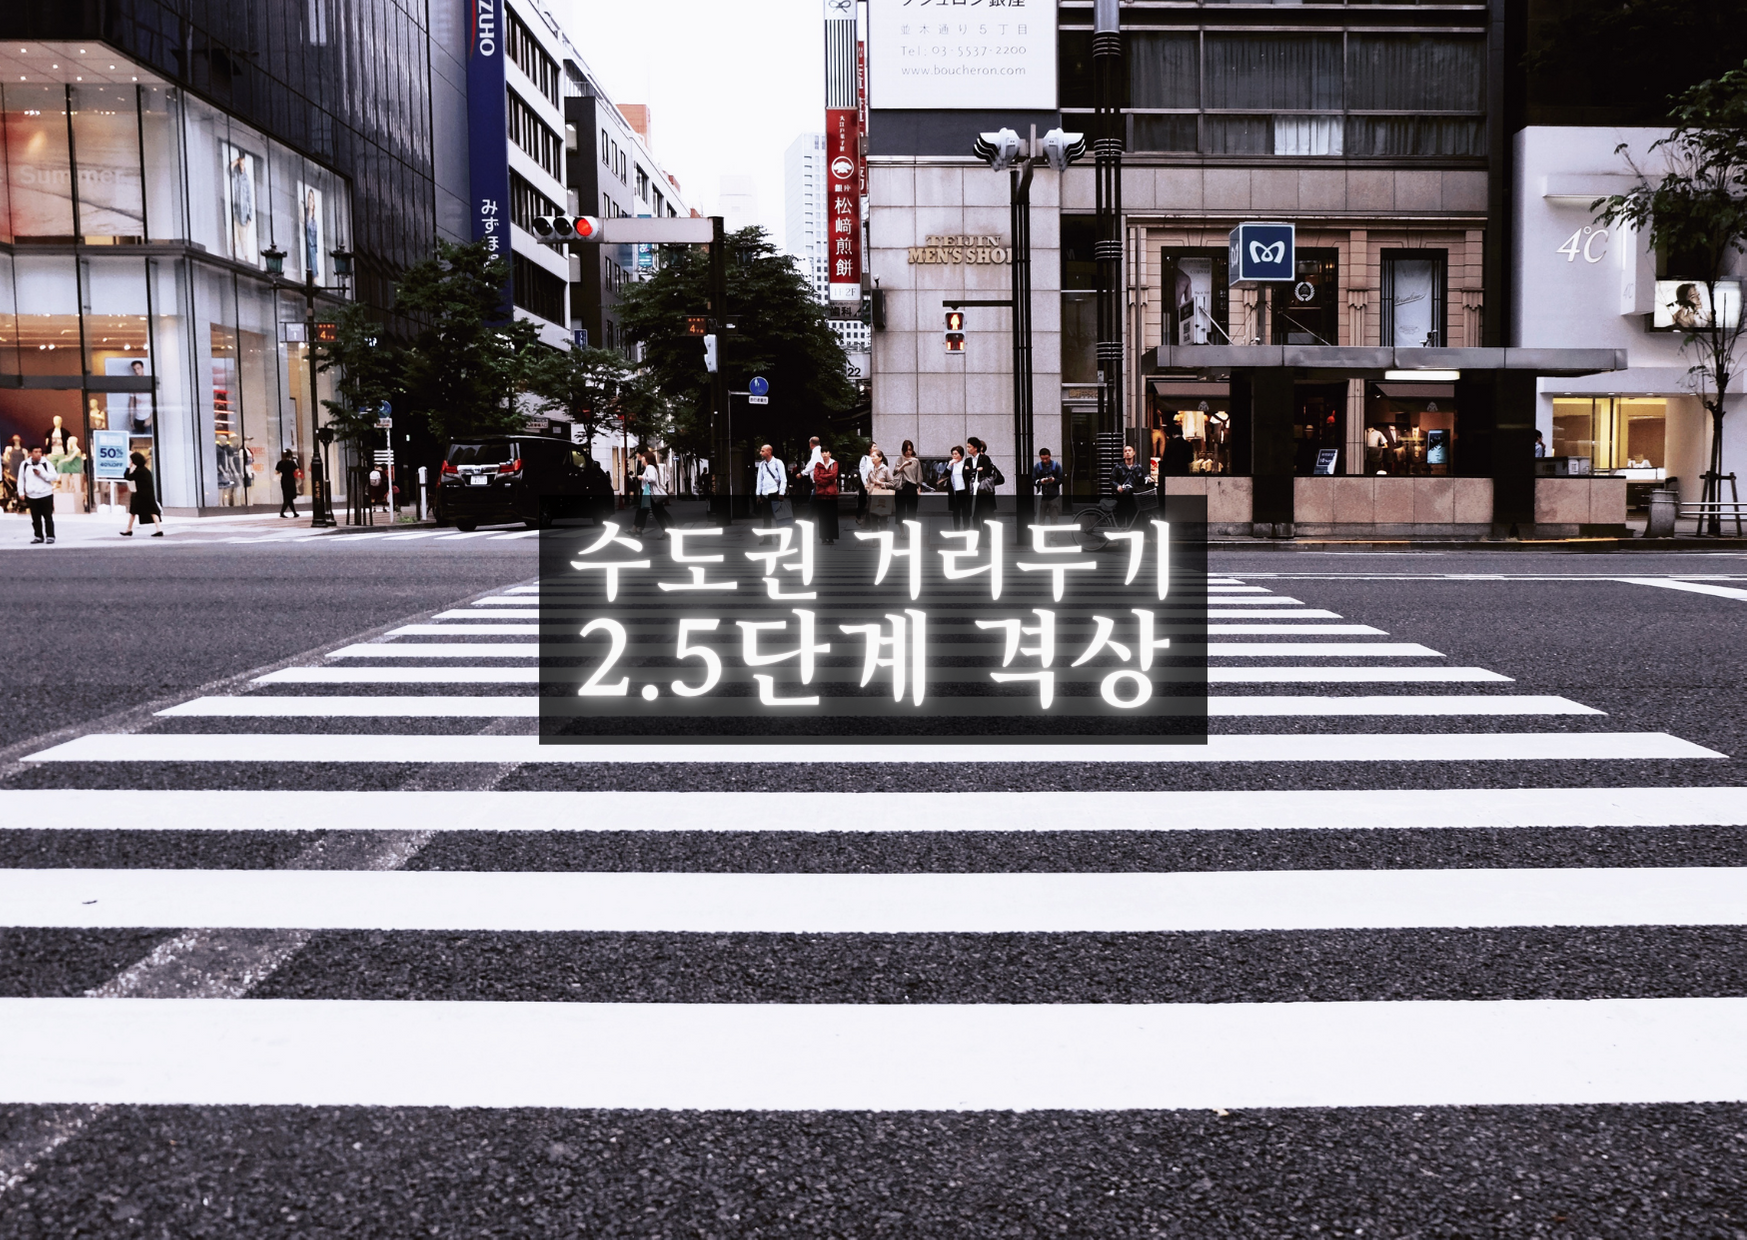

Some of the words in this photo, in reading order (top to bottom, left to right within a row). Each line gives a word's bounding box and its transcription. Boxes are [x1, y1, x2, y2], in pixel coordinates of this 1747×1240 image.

[901, 24, 1028, 35] 並木通り5丁目
[901, 46, 927, 56] Tel:
[901, 65, 1026, 75] www.boucheron.com
[17, 165, 124, 185] Summer
[926, 235, 1001, 247] TEIJIN
[908, 247, 962, 265] MEN'S
[846, 287, 857, 297] 2F
[848, 367, 861, 377] 22
